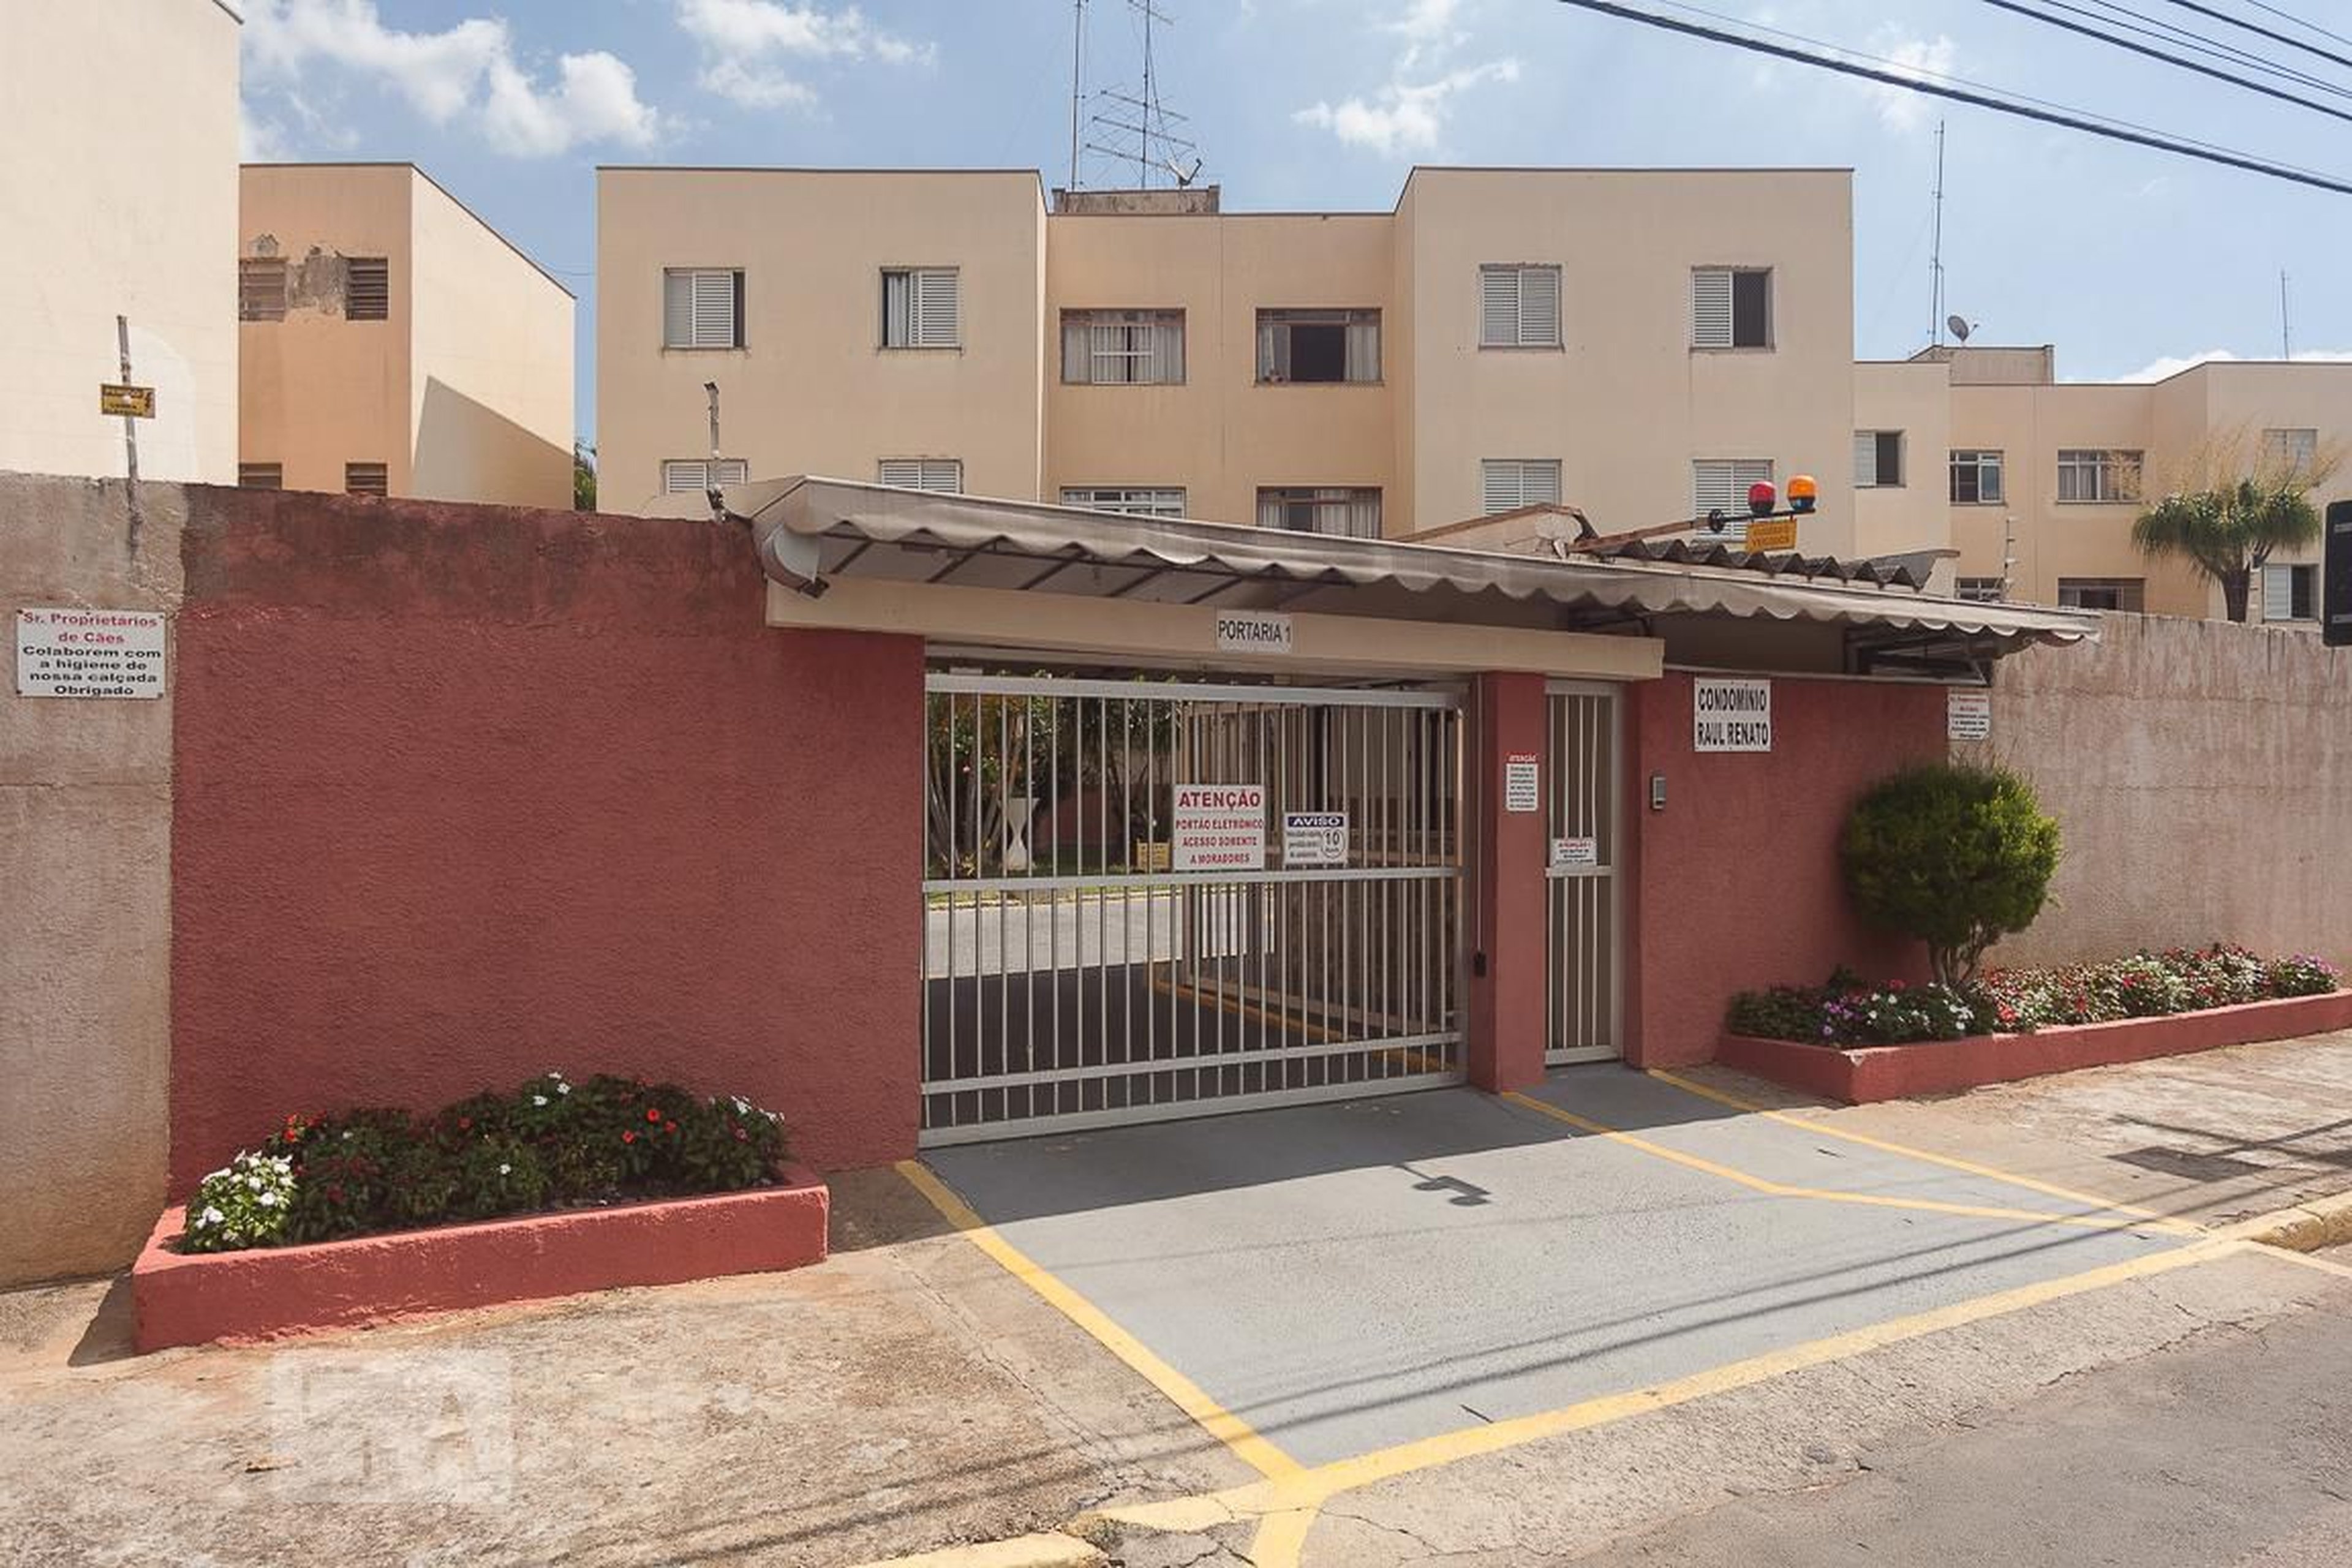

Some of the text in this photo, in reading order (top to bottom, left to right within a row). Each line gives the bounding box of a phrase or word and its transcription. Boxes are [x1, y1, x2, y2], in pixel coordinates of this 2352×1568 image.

[23, 612, 46, 624] Sr.
[59, 632, 125, 643] de Cães
[1218, 620, 1291, 643] PORTARIA 1
[23, 646, 161, 658] Colaborem com
[56, 659, 121, 671] higiene
[30, 673, 157, 684] nossa calçada
[55, 685, 134, 696] Obrigado
[1698, 687, 1767, 711] CONDOMÍNIO
[1698, 722, 1769, 745] RAUL RENATO
[1178, 789, 1261, 812] ATENÇÃO
[1175, 818, 1211, 830] PORTÃO
[1293, 817, 1341, 827] AVISO
[1183, 836, 1217, 846] ACESSO
[1325, 831, 1340, 846] 10
[1190, 854, 1197, 864] A
